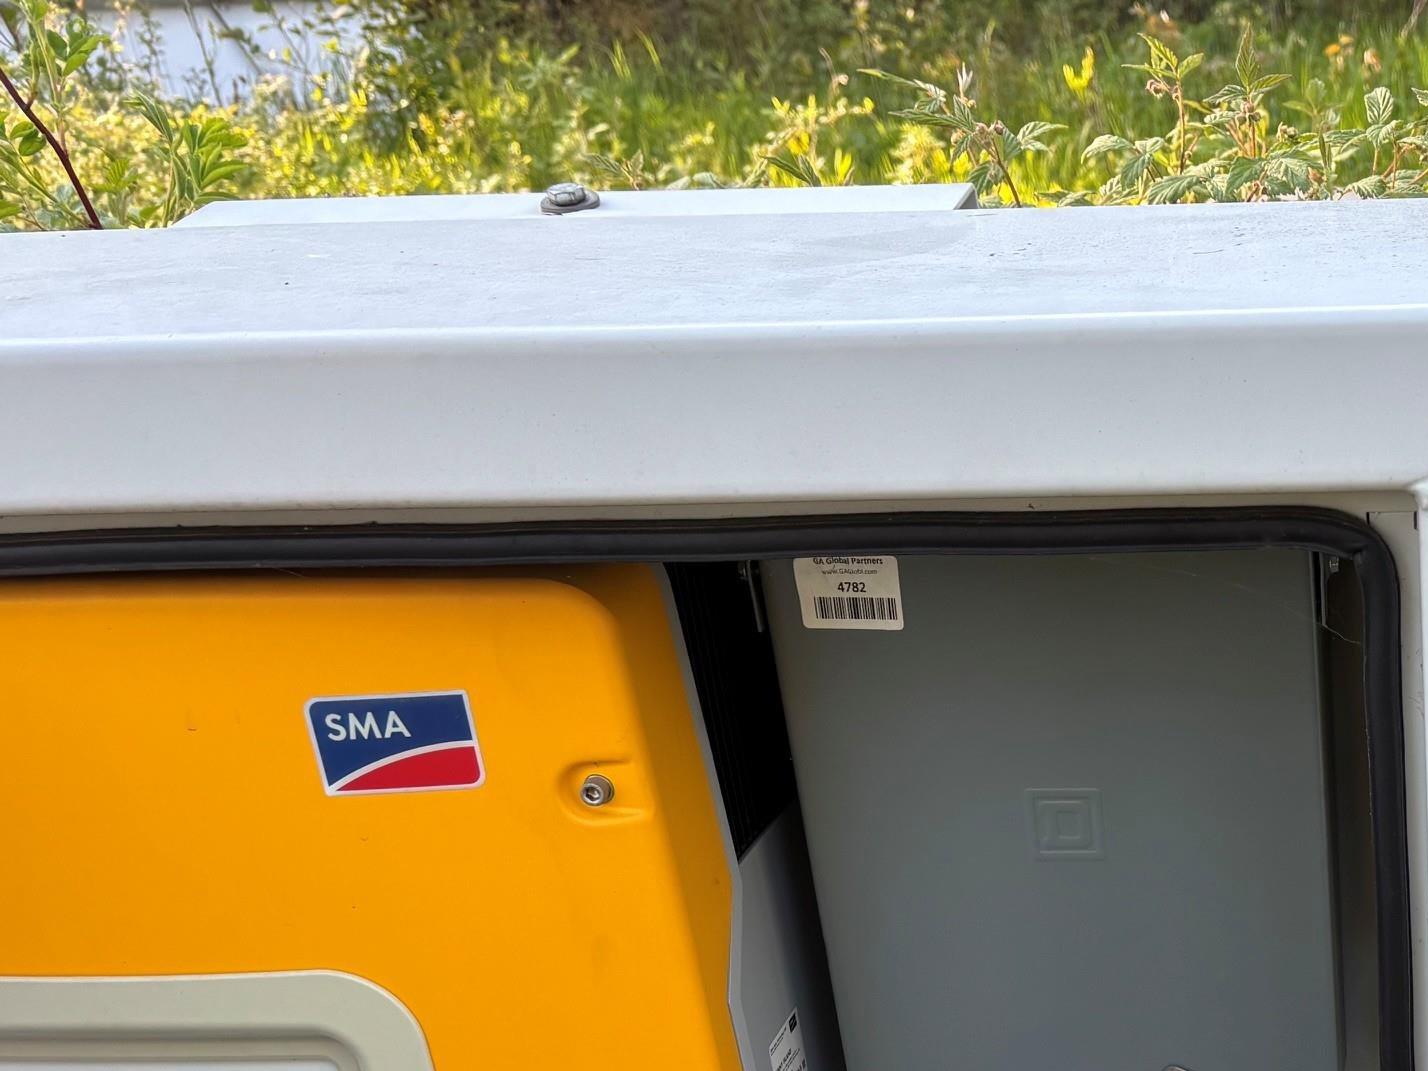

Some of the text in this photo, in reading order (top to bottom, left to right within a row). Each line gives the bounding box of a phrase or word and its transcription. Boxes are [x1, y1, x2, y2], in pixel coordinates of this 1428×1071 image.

[851, 557, 883, 565] Partners
[837, 582, 867, 592] 4782
[324, 710, 412, 742] SMA
